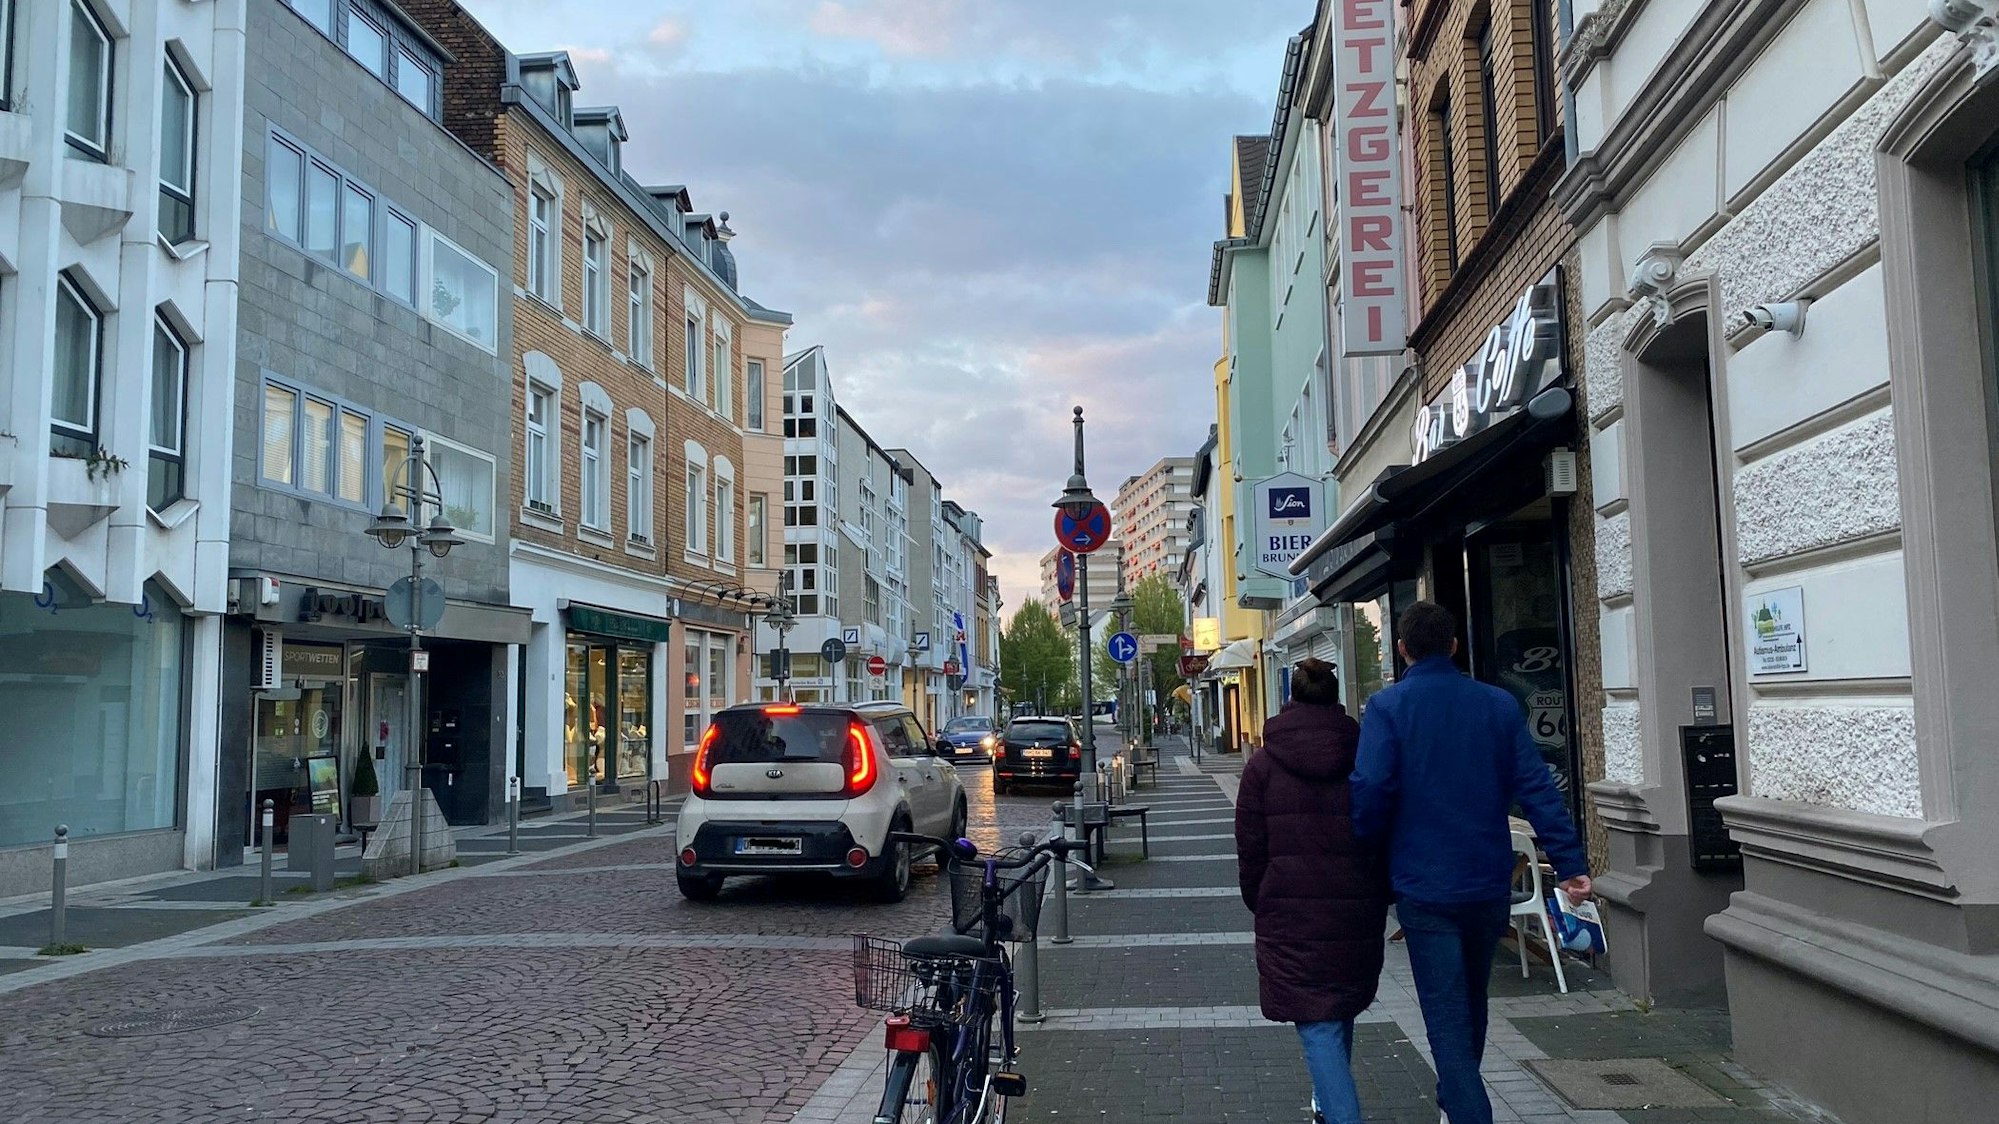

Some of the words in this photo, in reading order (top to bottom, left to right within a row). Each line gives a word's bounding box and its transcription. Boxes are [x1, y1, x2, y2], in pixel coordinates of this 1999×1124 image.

[1273, 494, 1306, 512] Sion
[1269, 535, 1312, 551] BIER
[1262, 552, 1301, 563] BRUN
[284, 650, 339, 664] SPORTWETTEN
